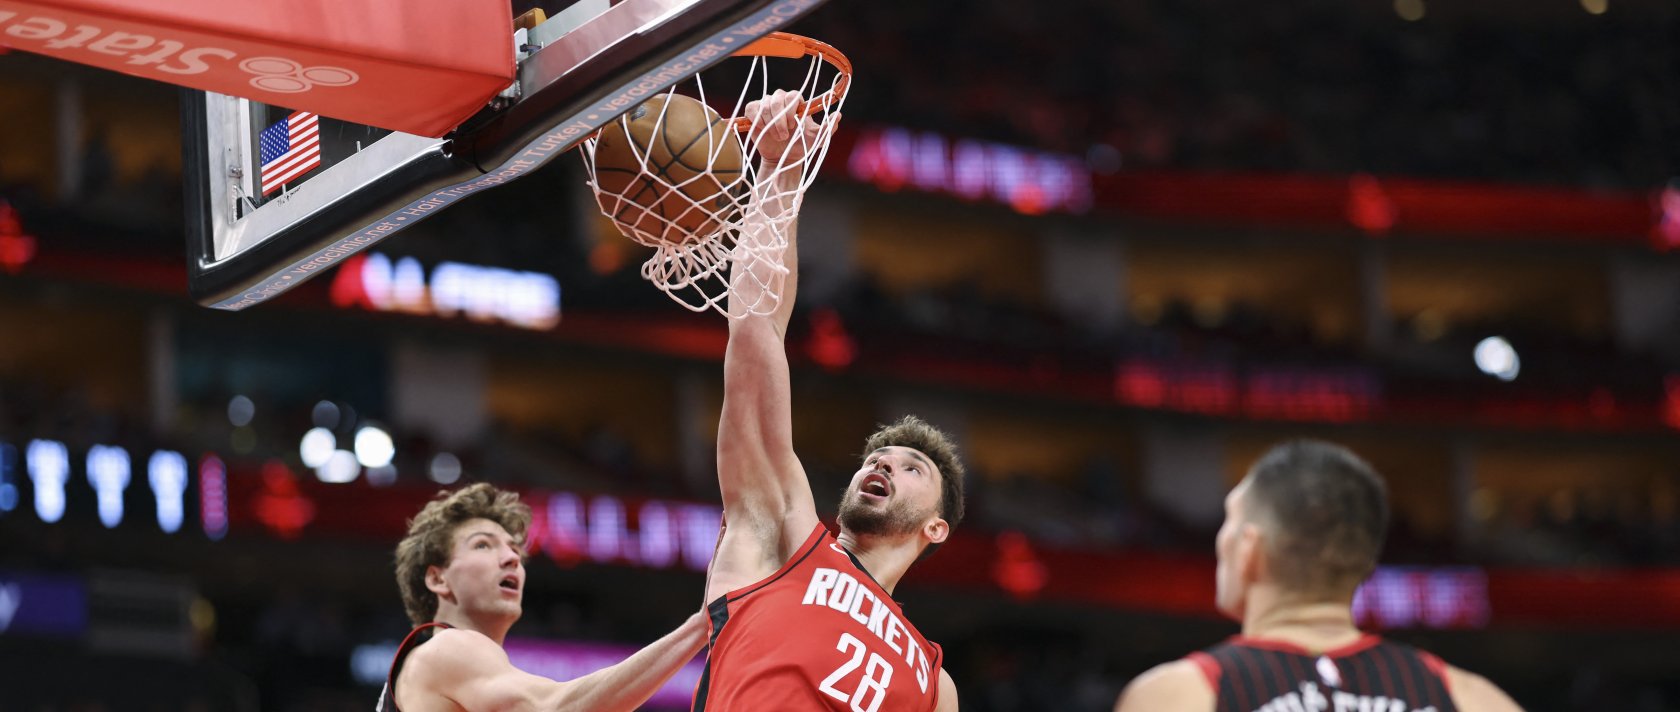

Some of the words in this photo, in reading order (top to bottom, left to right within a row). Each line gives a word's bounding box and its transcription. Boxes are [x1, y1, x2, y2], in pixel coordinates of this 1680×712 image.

[291, 220, 401, 275] veraclinic.net
[404, 196, 445, 217] Hair
[436, 159, 535, 197] Transplant
[526, 120, 594, 157] Turkey
[600, 43, 727, 112] veraclinic.net
[801, 567, 930, 694] ROCKETS
[818, 632, 894, 712] 28
